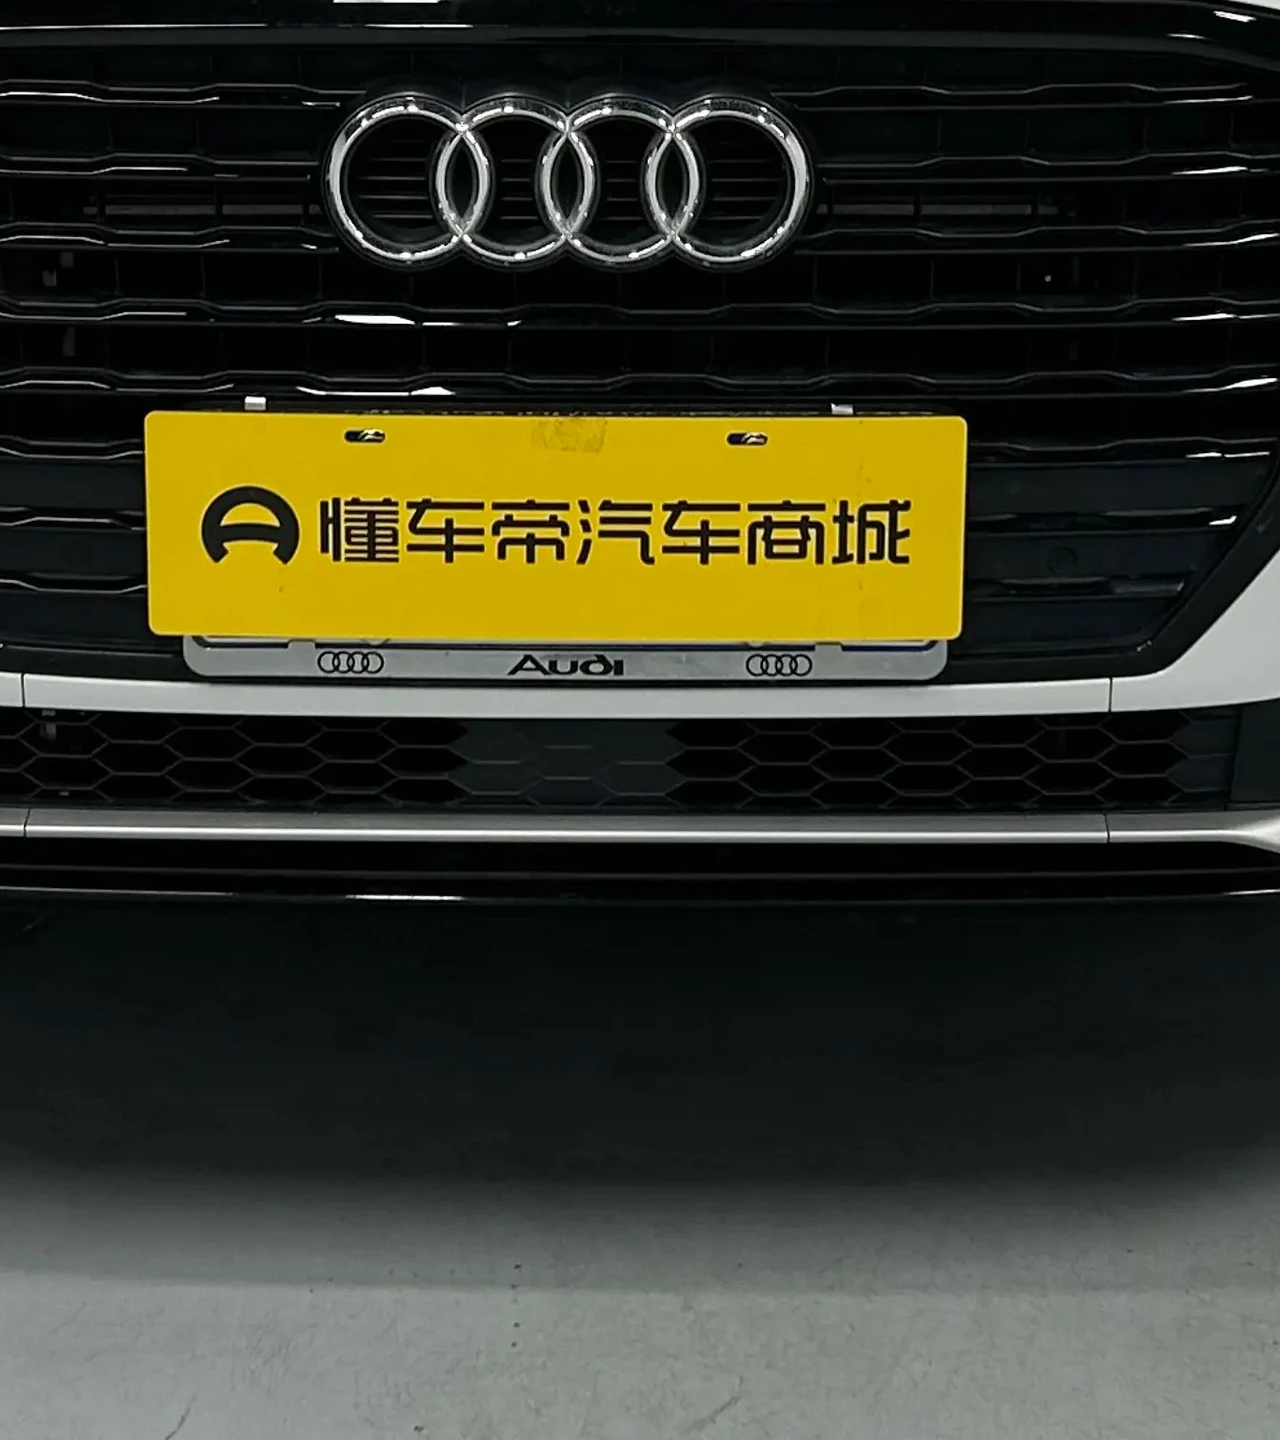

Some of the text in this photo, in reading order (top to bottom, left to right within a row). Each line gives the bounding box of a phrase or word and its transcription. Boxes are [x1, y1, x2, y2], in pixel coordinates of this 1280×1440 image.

[319, 497, 912, 566] 懂车帝汽车商城
[507, 654, 624, 676] Audi
